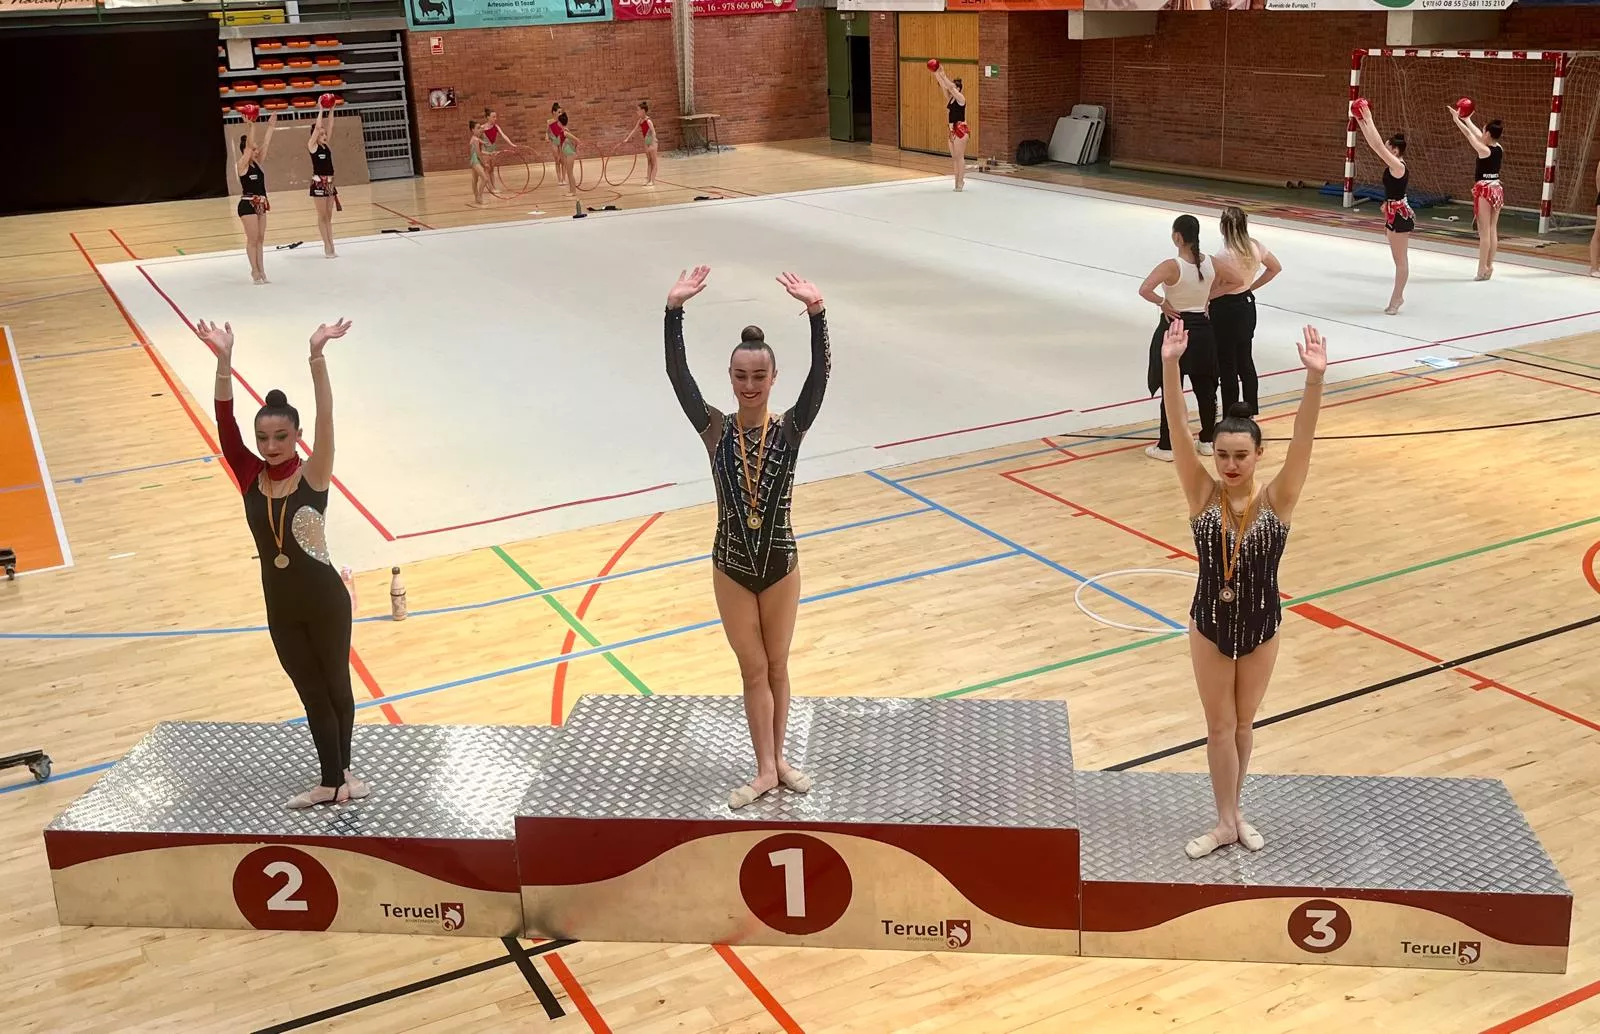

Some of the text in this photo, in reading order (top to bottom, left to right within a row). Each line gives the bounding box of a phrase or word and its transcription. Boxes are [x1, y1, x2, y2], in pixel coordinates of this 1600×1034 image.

[736, 2, 750, 10] 606
[751, 1, 764, 9] 006
[263, 861, 309, 911] 2
[768, 848, 806, 917] 1
[380, 903, 439, 918] Teruel
[881, 920, 944, 936] Teruel
[1303, 909, 1337, 947] 3
[1400, 941, 1457, 955] Teruel
